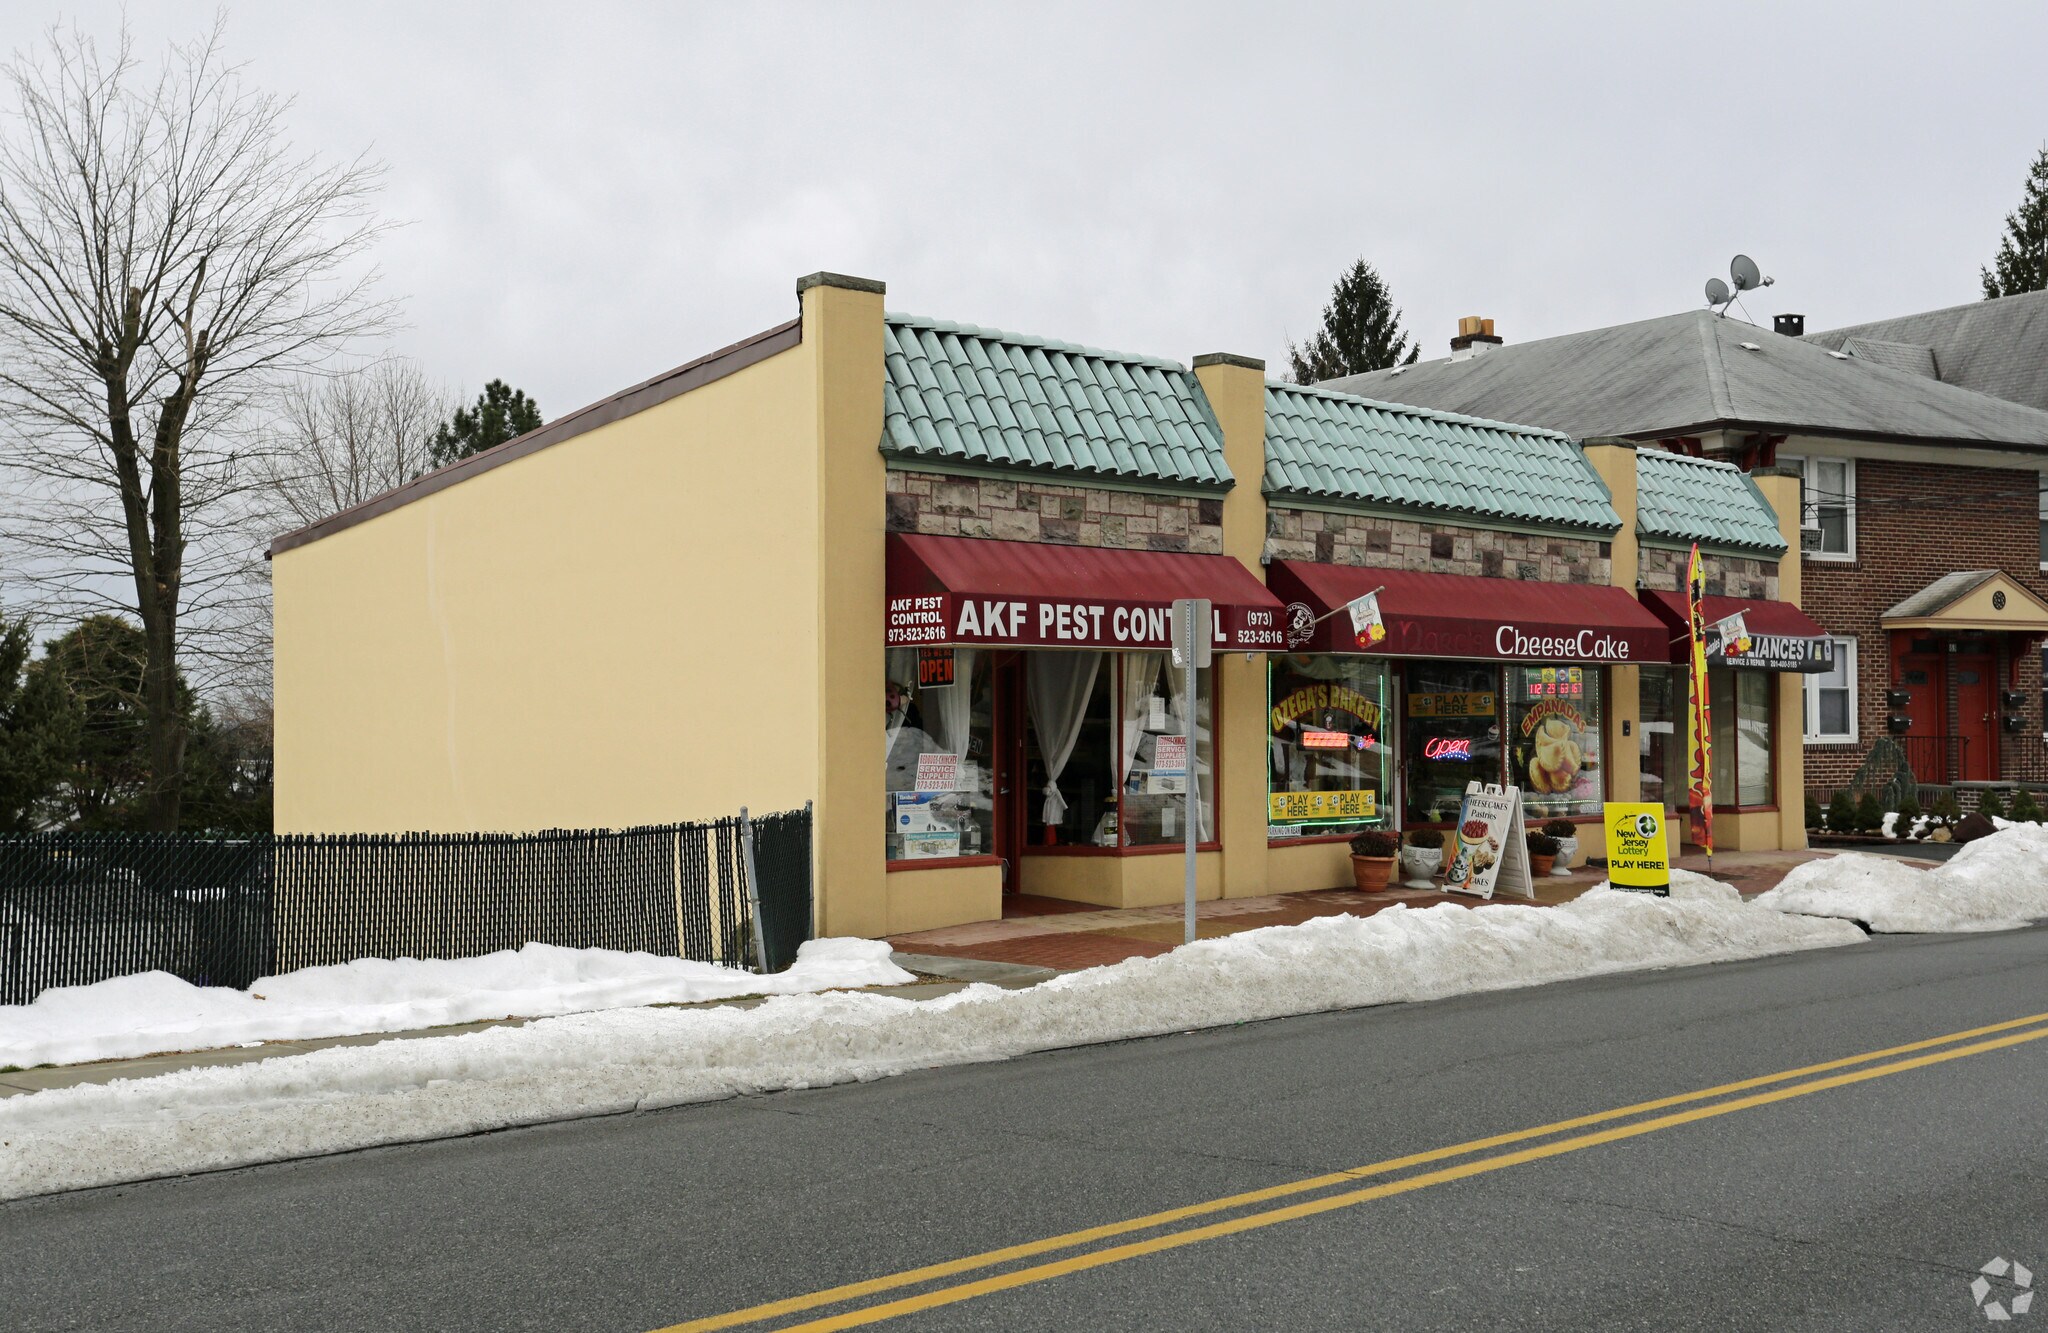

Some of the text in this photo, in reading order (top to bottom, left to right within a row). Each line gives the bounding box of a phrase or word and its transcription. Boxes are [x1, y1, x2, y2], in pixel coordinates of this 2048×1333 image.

[891, 597, 943, 611] AKF PEST
[891, 611, 943, 625] CONTROL
[956, 600, 1227, 642] AKF PEST CONL
[1247, 611, 1273, 627] (973)
[888, 626, 946, 642] 973-523-2616
[1237, 630, 1283, 643] 523-2616
[1495, 625, 1630, 659] CheeseCake
[1726, 657, 1746, 666] SERVICE
[1745, 658, 1750, 666] &
[1749, 658, 1766, 667] REPAIR
[920, 659, 953, 683] OPEN
[1434, 694, 1469, 705] PLAY
[1271, 684, 1382, 732] OZEGA'S BAKERY
[1434, 704, 1469, 715] HERE
[1521, 699, 1587, 737] EMPANADAS
[1425, 737, 1471, 759] Open
[916, 781, 954, 790] 973-523-2616
[1287, 794, 1309, 806] PLAY
[1340, 793, 1360, 804] PLAY
[1287, 805, 1309, 817] HERE
[1339, 803, 1360, 815] HERE
[1471, 809, 1497, 820] Pastries
[1616, 829, 1636, 838] New
[1622, 838, 1649, 848] Jersey
[1618, 846, 1649, 857] Lottery
[1611, 860, 1665, 870] PLAY HERE!
[1469, 876, 1489, 887] CAKES
